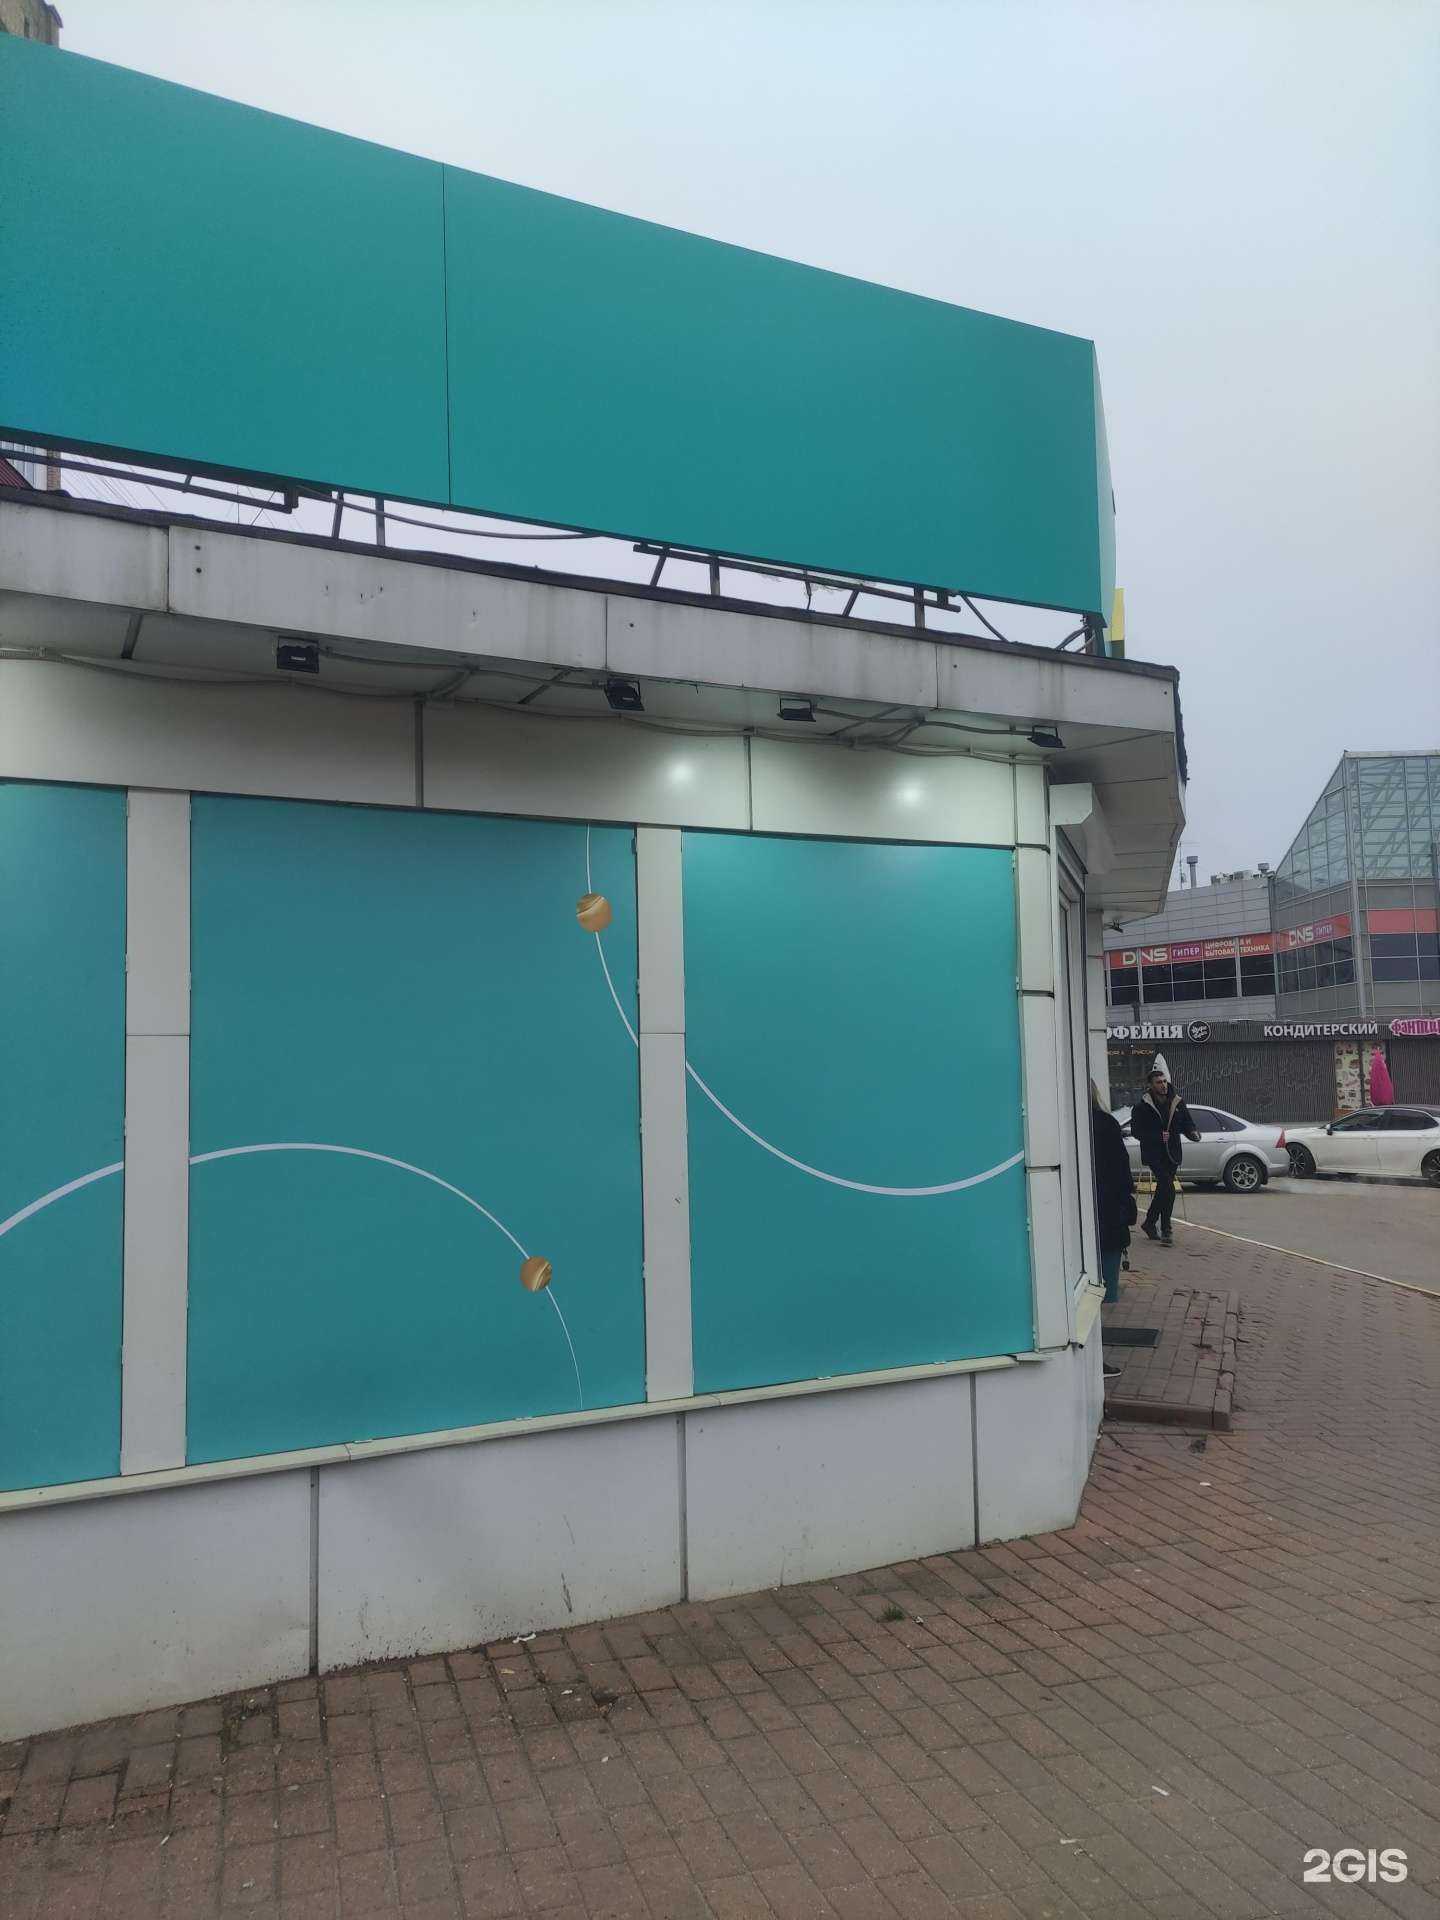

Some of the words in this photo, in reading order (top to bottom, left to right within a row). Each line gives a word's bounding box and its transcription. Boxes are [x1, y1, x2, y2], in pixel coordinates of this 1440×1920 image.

[1205, 936, 1244, 950] ЦИФРОВЯ
[1289, 926, 1313, 946] DNS
[1173, 947, 1200, 957] ГИПЕР
[1240, 943, 1270, 953] ТЕХНИКА
[1122, 947, 1168, 966] DNS
[1264, 1020, 1378, 1038] КОНДИТЕРСКИЙ
